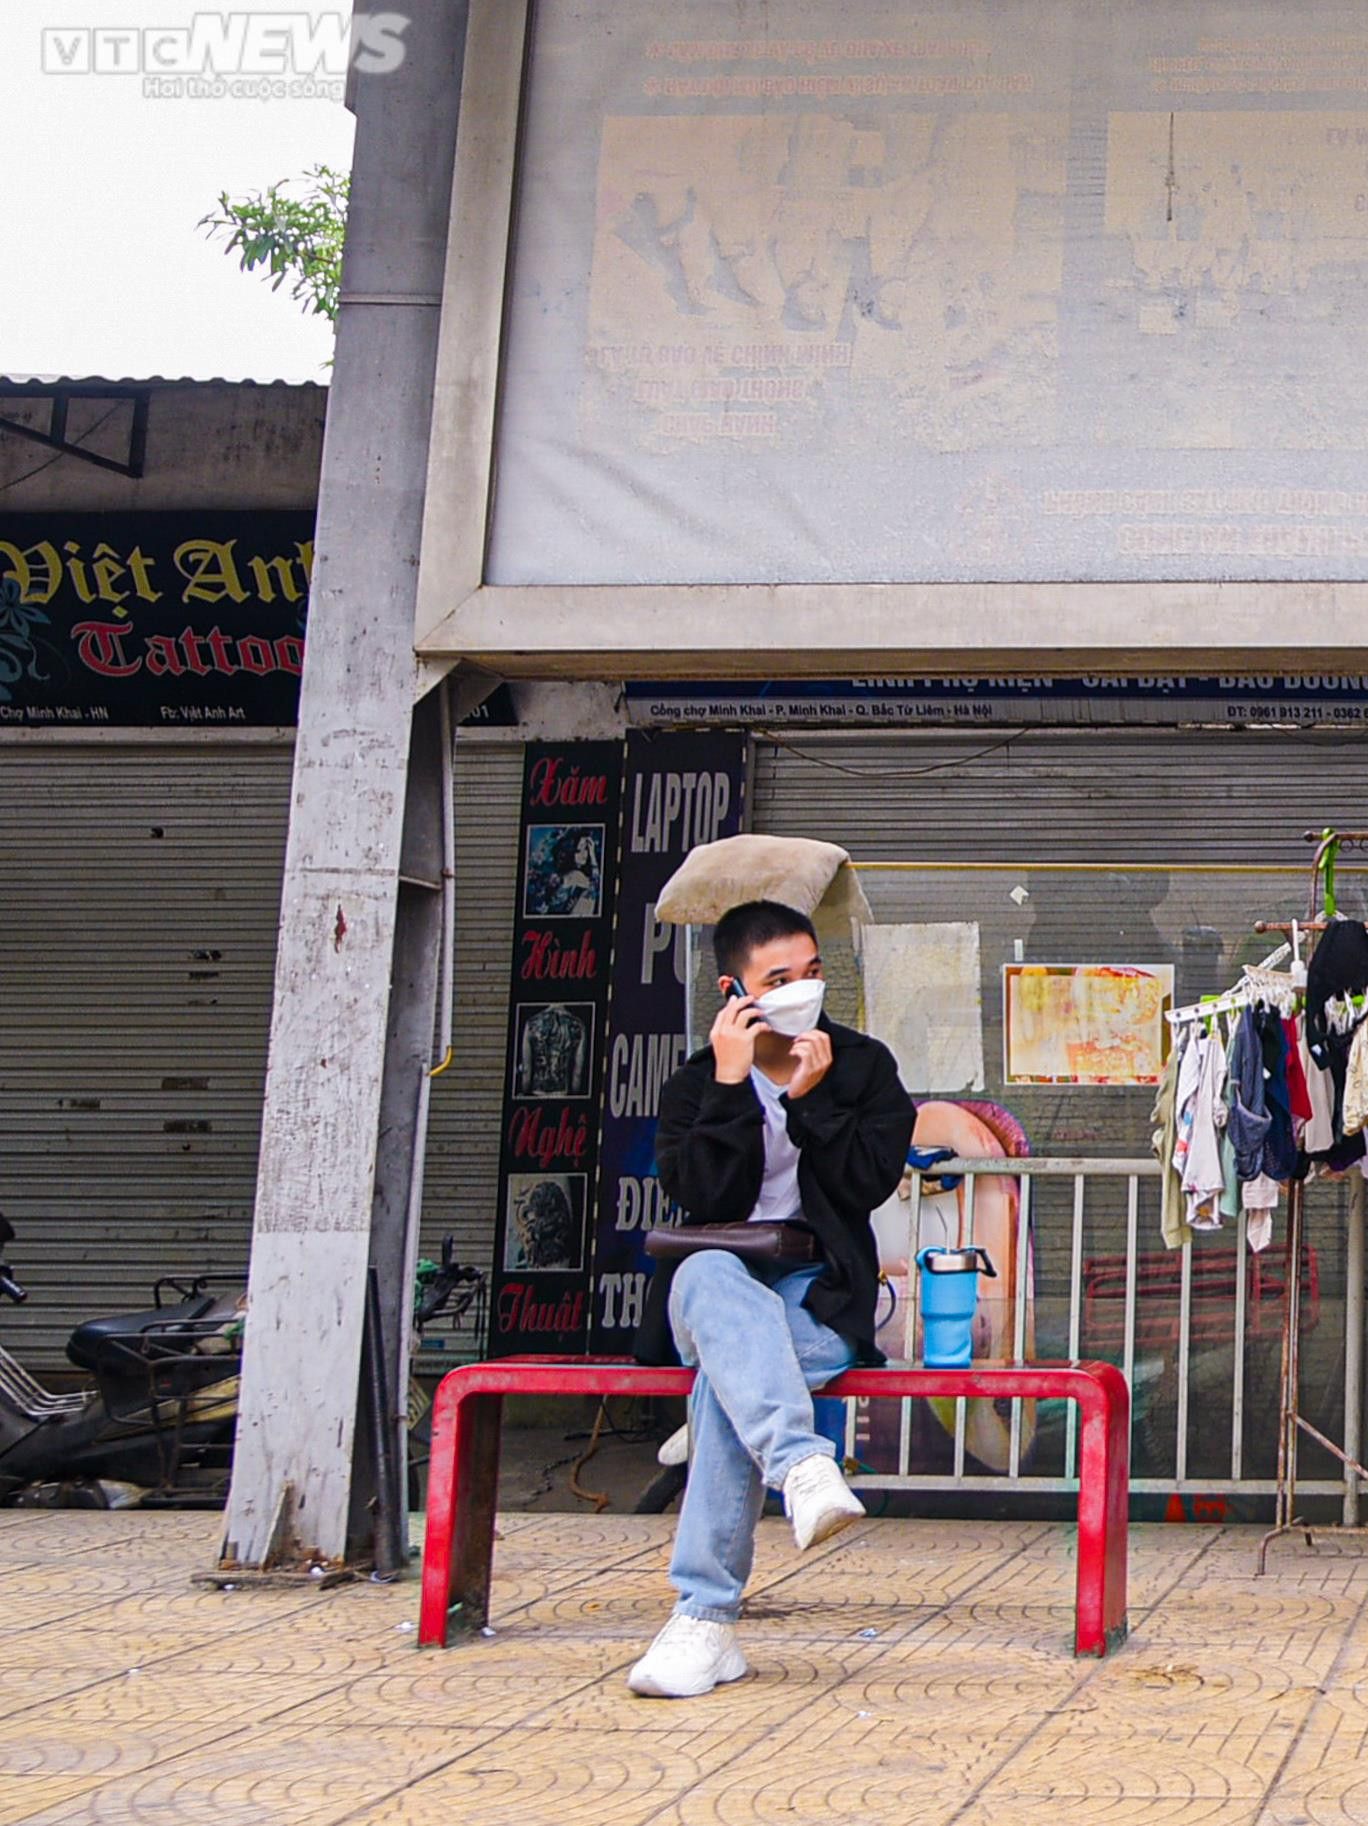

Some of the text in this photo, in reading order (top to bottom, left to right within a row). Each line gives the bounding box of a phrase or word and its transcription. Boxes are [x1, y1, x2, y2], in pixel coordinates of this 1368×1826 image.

[0, 538, 163, 619] Việt
[27, 706, 53, 719] Minh
[56, 706, 82, 719] Khai
[90, 706, 109, 719] HN
[205, 706, 228, 719] Anh
[229, 706, 247, 719] Art
[464, 705, 489, 718] 01
[650, 703, 680, 717] Cổng
[684, 705, 706, 717] chợ
[709, 705, 737, 716] Minh
[739, 705, 766, 716] Khai
[776, 705, 786, 716] P.
[789, 705, 817, 716] Minh
[820, 705, 846, 716] Khai
[856, 705, 869, 716] Q.
[872, 702, 894, 716] Bắc
[916, 703, 944, 716] Liêm
[953, 704, 970, 716] Hà
[973, 704, 992, 718] Nội
[1227, 706, 1247, 718] ĐT:
[1250, 706, 1276, 718] 0961
[1279, 706, 1300, 718] 913
[1303, 707, 1322, 718] 211
[1334, 707, 1361, 719] 0362
[530, 757, 608, 807] Xăm
[631, 771, 730, 853] LAPTOP
[520, 930, 597, 980] Hình
[508, 1106, 587, 1170] Nghệ
[498, 1283, 584, 1343] Thuật
[601, 1272, 655, 1328] TH
